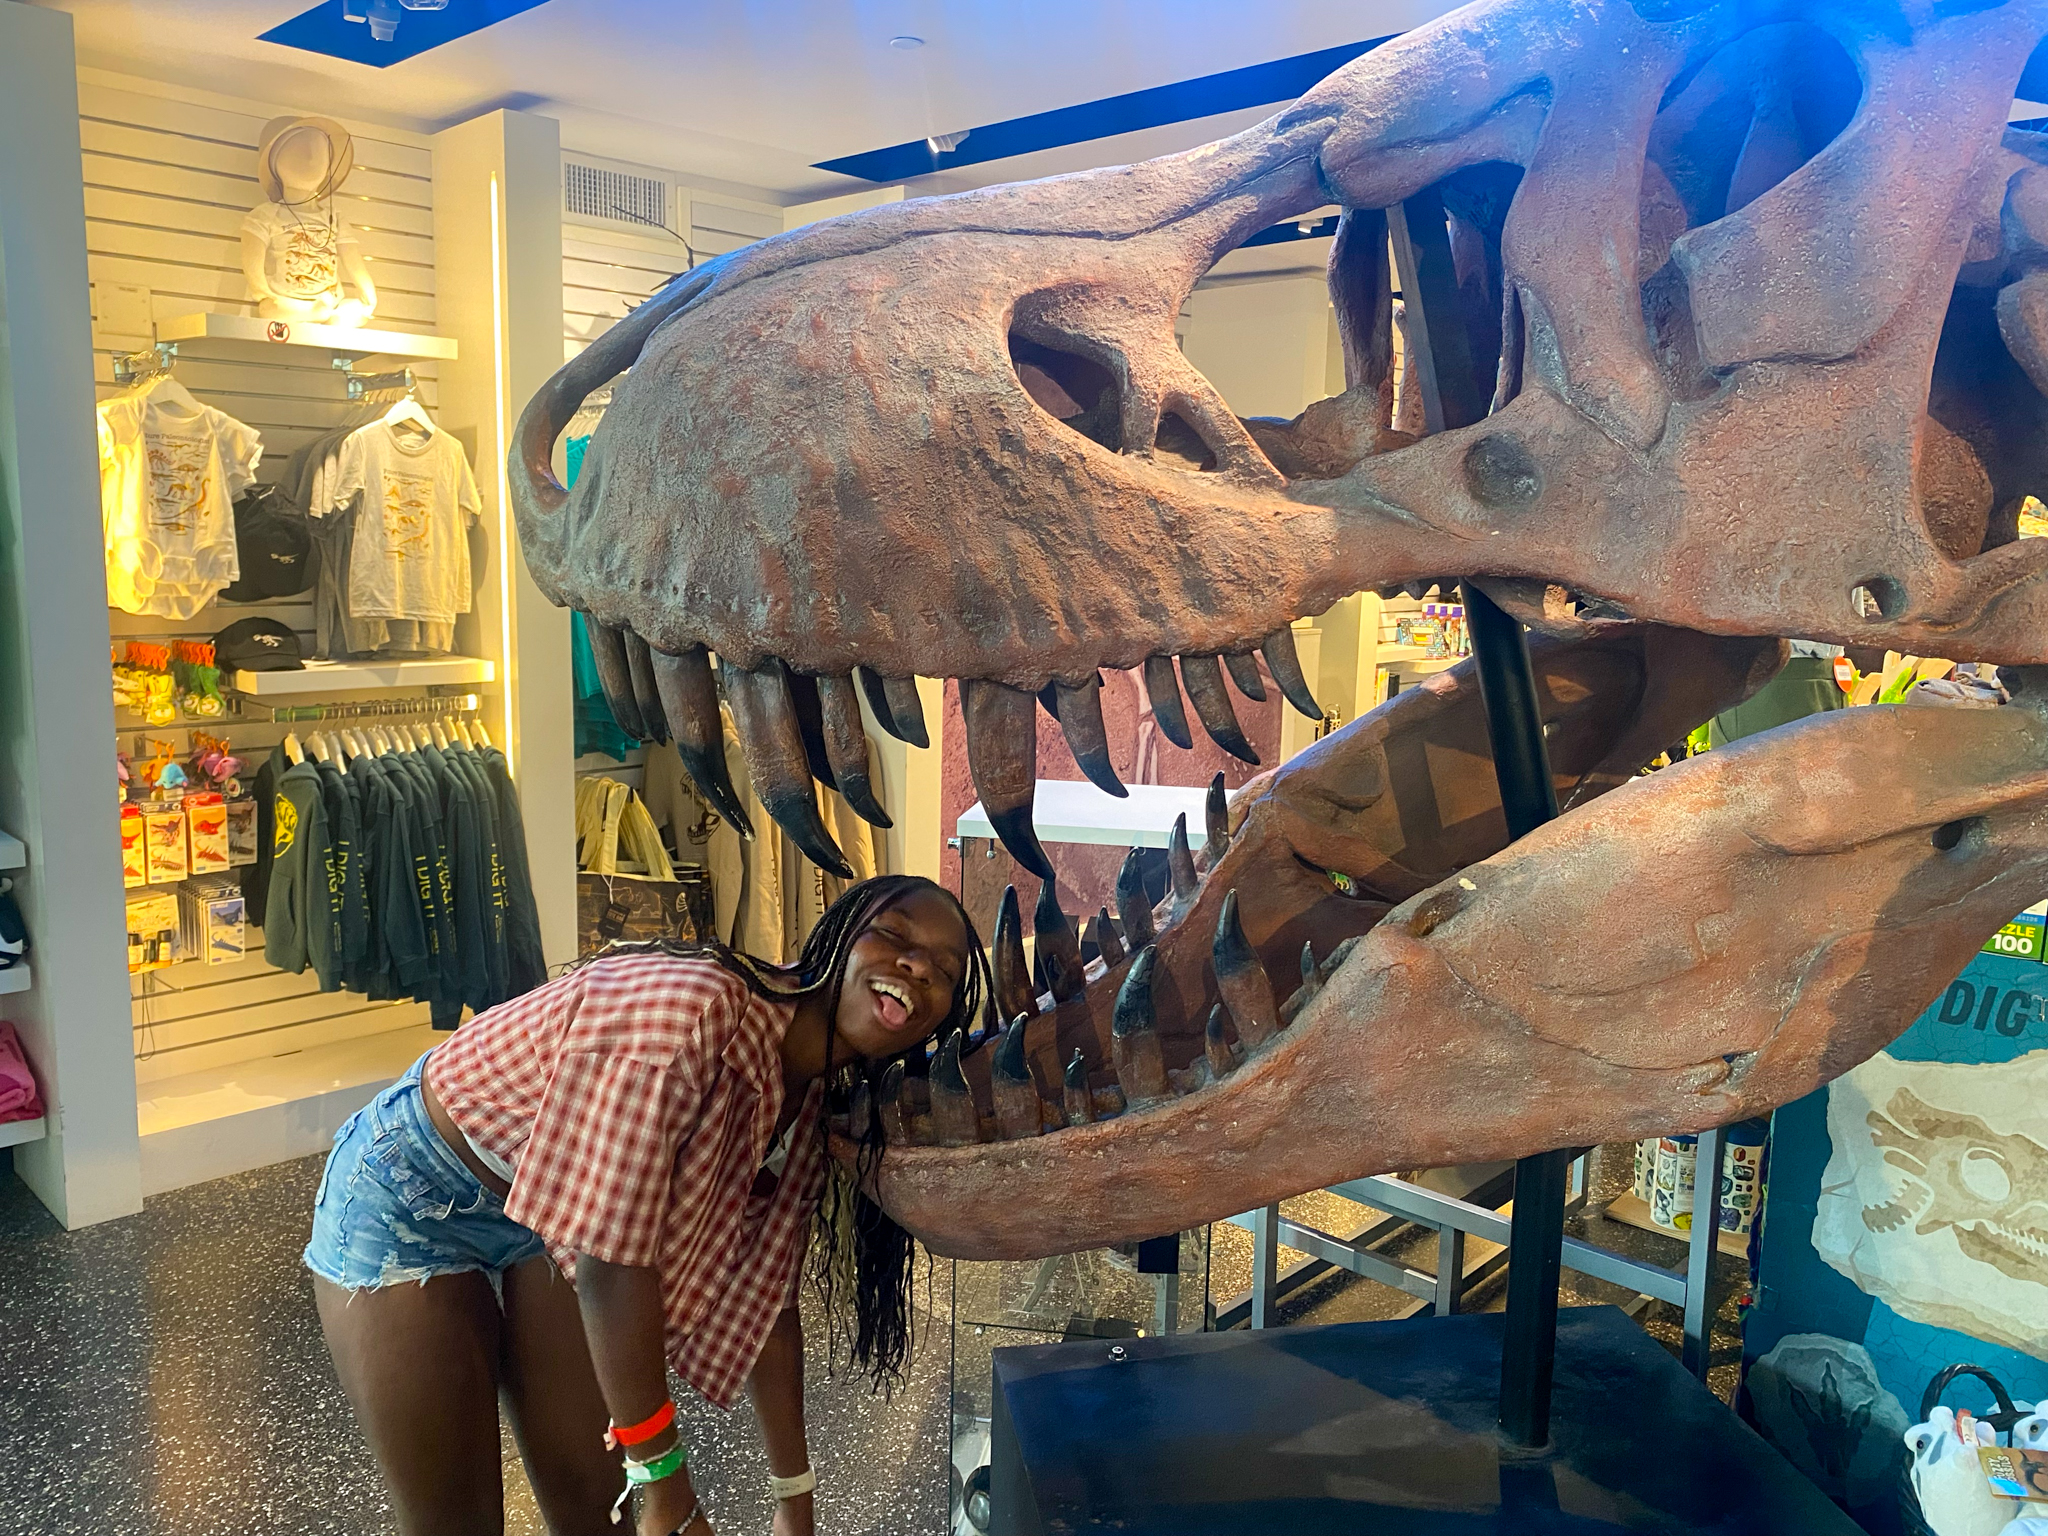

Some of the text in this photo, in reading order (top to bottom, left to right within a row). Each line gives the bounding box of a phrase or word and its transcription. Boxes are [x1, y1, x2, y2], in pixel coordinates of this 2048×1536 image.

[1991, 933, 2033, 954] 100
[1938, 979, 2032, 1037] DIG
[1997, 1455, 2017, 1482] OSSILS
